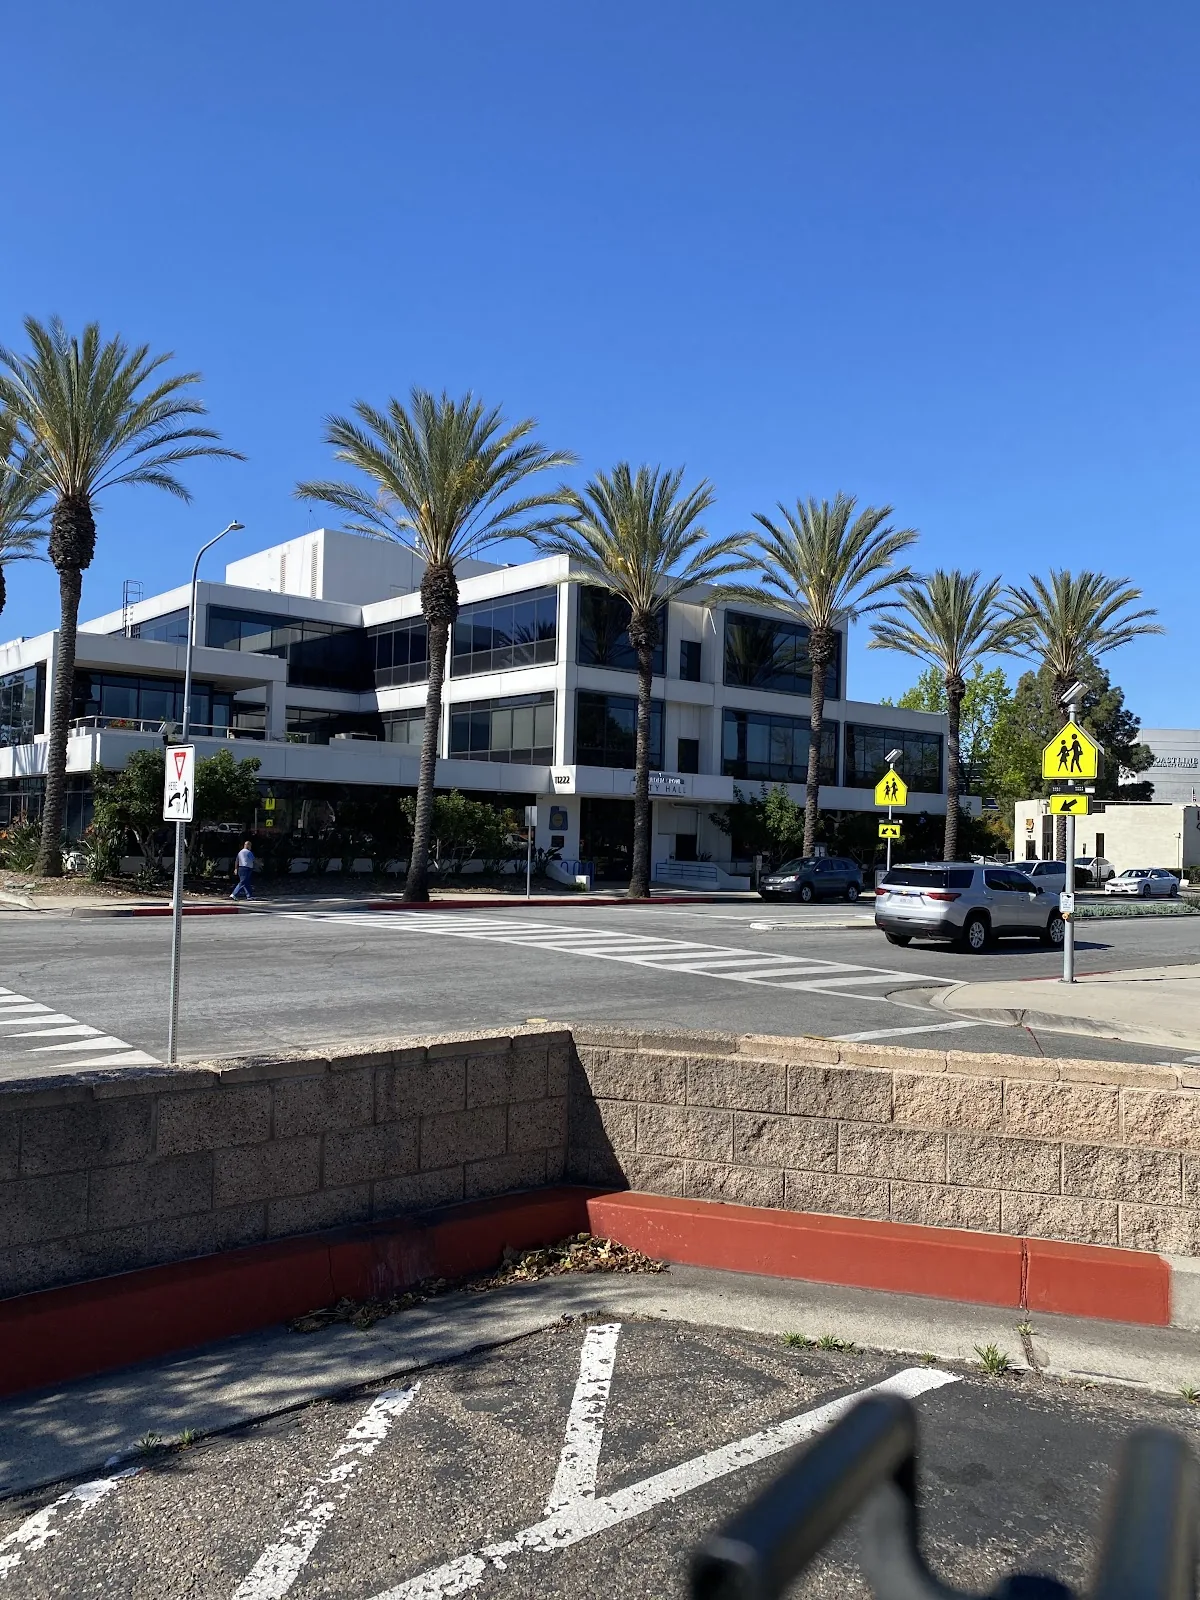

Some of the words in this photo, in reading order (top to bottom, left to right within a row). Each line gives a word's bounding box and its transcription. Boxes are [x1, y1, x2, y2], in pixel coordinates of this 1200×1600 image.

[1154, 757, 1199, 765] OASTLINE
[554, 775, 570, 784] 11222
[665, 785, 686, 794] HALL
